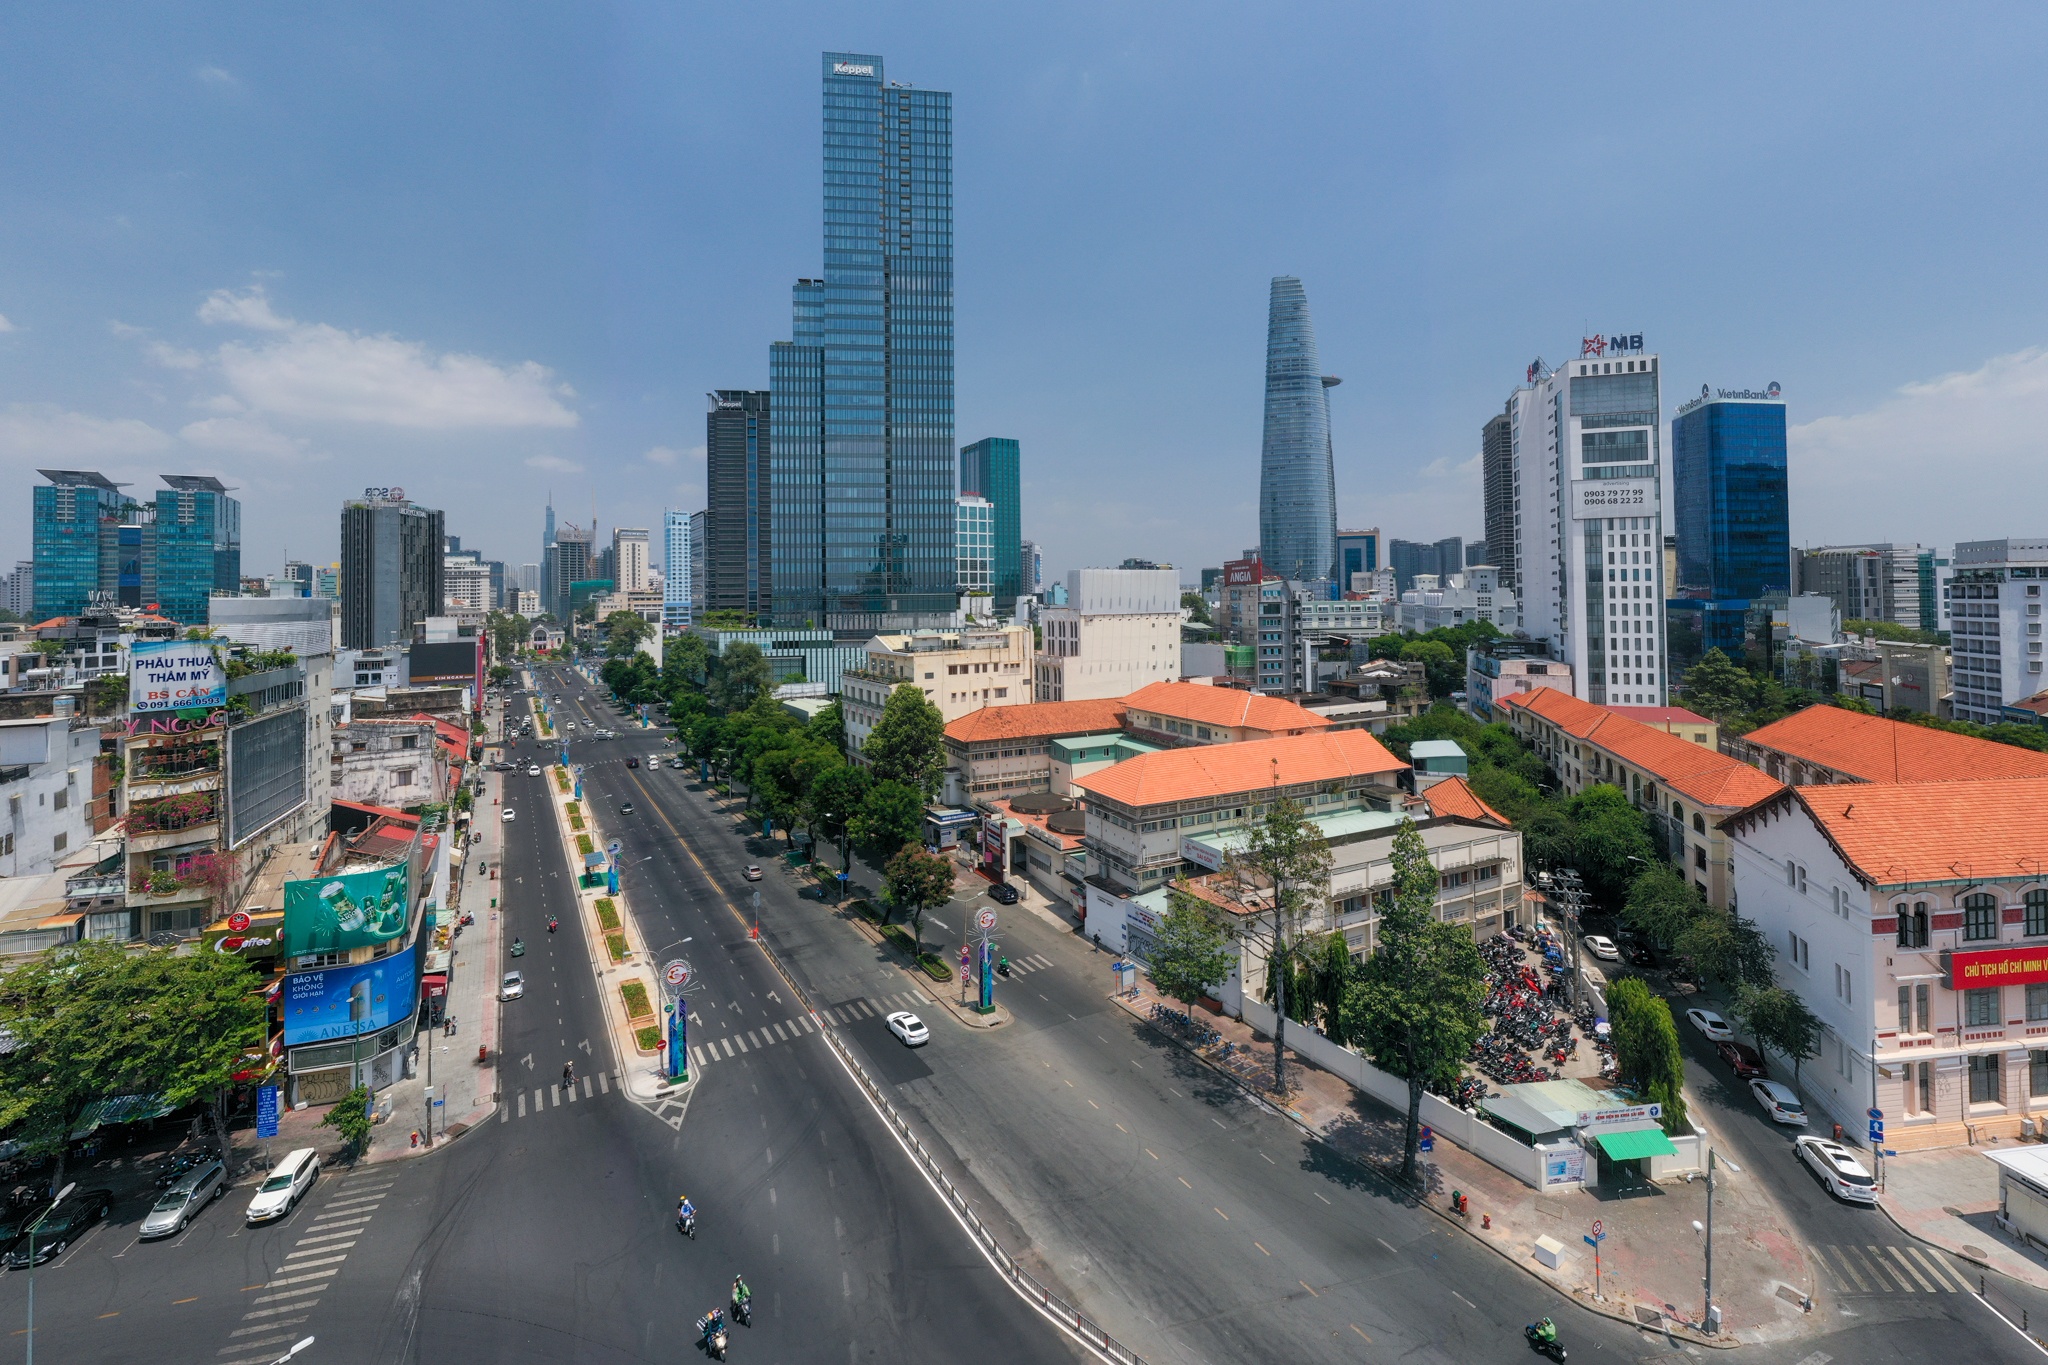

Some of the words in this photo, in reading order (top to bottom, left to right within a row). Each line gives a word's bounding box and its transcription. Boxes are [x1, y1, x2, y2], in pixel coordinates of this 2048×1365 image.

[835, 63, 872, 76] Keppel
[1610, 334, 1644, 350] MB
[1717, 388, 1768, 400] VietinBank
[190, 668, 210, 681] MỸ
[147, 690, 170, 701] BS
[150, 701, 170, 709] 091
[173, 700, 192, 708] 666
[195, 697, 220, 706] 0593
[1964, 962, 1980, 977] CHỦ
[1981, 963, 1997, 978] TỊCH
[2009, 959, 2022, 974] CHÍ
[2023, 959, 2042, 972] MINH
[293, 975, 311, 984] BẢO
[320, 1020, 377, 1039] ANESSA
